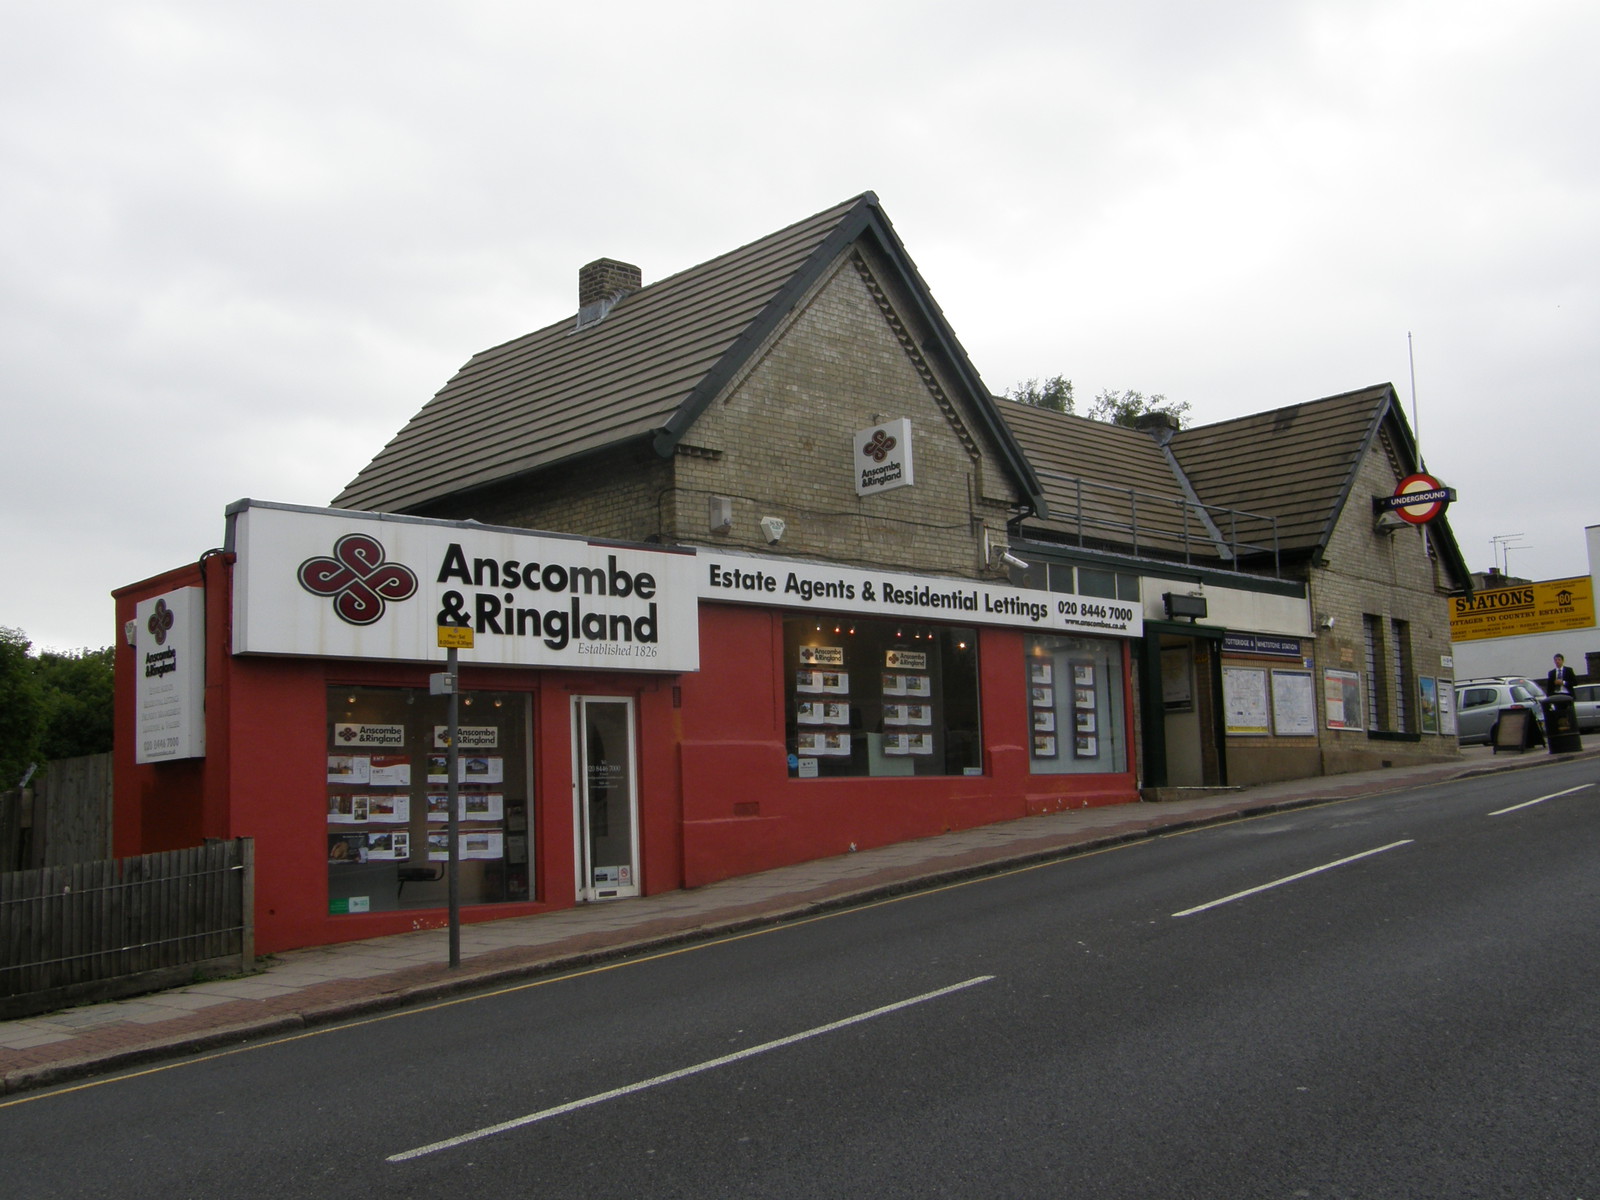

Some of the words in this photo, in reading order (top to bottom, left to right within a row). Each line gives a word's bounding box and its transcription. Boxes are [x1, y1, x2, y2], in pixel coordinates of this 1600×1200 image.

[862, 461, 901, 478] Anscombe
[862, 469, 902, 488] &Ringland
[1391, 491, 1446, 505] UNDERGROUND
[437, 543, 656, 599] Anscombe
[709, 564, 777, 592] Estate
[784, 572, 855, 601] Agents
[861, 580, 876, 601] &
[882, 582, 978, 612] Residential
[984, 593, 1048, 622] Lettings
[1456, 590, 1535, 612] STATONS
[437, 590, 658, 650] &Ringland
[1058, 600, 1077, 615] 020
[1080, 603, 1107, 618] 8446
[1109, 606, 1132, 621] 7000
[1449, 617, 1483, 626] OTTAGES
[1499, 611, 1535, 621] COUNTRY
[1539, 606, 1575, 616] ESTATES
[1065, 617, 1127, 630] www.anscombes.co.uk
[145, 645, 176, 664] Anscombe
[578, 642, 631, 656] Established
[634, 645, 658, 657] 1826
[359, 726, 402, 735] Anscombe
[359, 734, 402, 744] &Ringland
[457, 728, 496, 737] Anscombe
